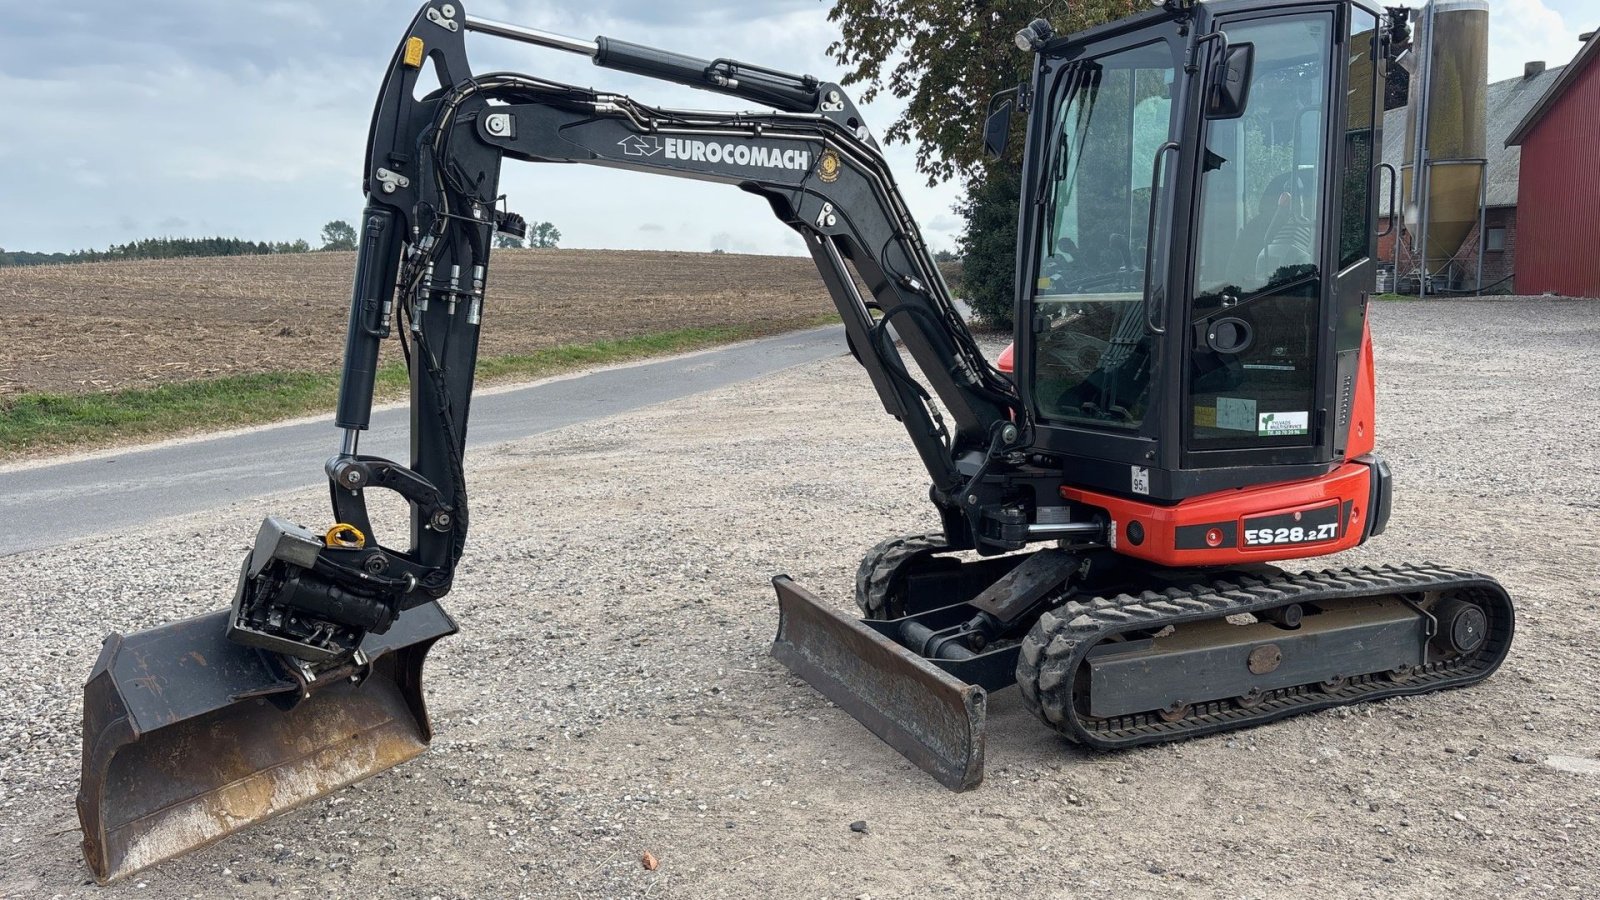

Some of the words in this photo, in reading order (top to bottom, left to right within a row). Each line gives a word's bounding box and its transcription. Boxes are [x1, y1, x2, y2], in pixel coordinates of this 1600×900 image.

[664, 138, 808, 170] EUROCOMACH
[1134, 478, 1143, 491] 95
[1244, 522, 1338, 545] ES28.2ZT
